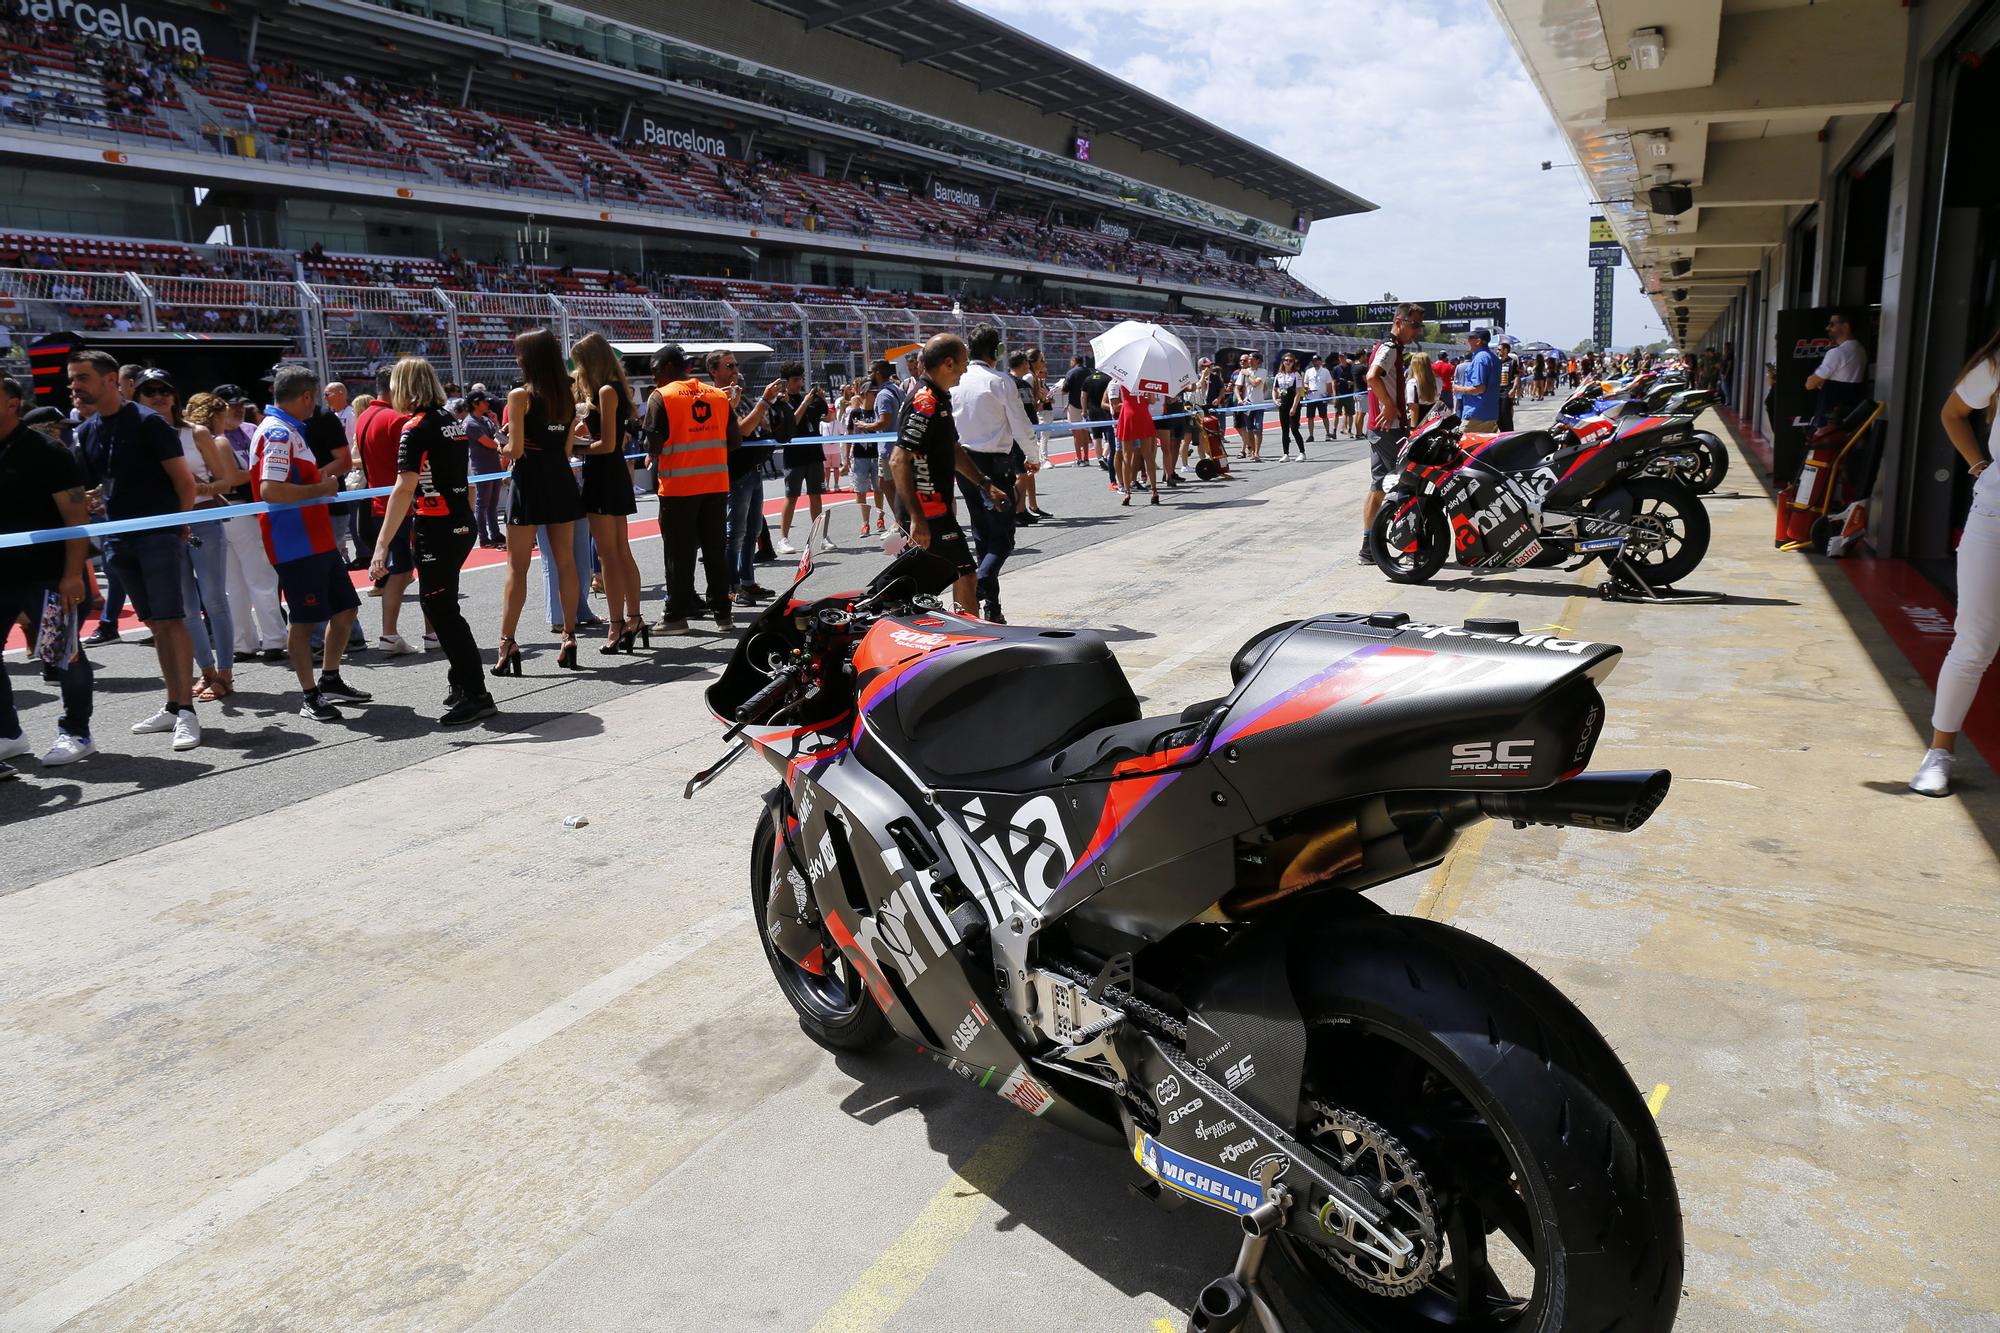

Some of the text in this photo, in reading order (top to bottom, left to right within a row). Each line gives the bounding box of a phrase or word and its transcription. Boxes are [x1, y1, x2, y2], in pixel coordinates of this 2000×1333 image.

[643, 119, 726, 157] Barcelona
[934, 182, 980, 208] Barcelona
[1101, 219, 1129, 239] Barcelona
[1291, 308, 1340, 318] MONSTER
[1368, 305, 1397, 315] MONS
[1449, 301, 1500, 312] MONSTER
[1145, 382, 1163, 391] GIVI
[547, 424, 565, 432] aprilia
[1447, 497, 1460, 510] sky
[1502, 529, 1522, 548] CASE
[1514, 542, 1542, 567] Castrol
[889, 629, 948, 646] aprilia
[896, 641, 933, 652] RACING
[1397, 622, 1600, 654] apilia
[1572, 704, 1600, 762] racer
[1451, 739, 1536, 764] SC
[1450, 763, 1532, 771] PROJECT
[1569, 811, 1617, 827] SC
[808, 852, 826, 885] sky
[951, 1013, 981, 1052] CASE
[1205, 1040, 1232, 1063] SHAREBOT
[1224, 1053, 1255, 1085] SC
[1227, 1069, 1256, 1090] PROJECT
[1204, 1119, 1227, 1136] SPRINT
[1212, 1121, 1237, 1139] FILTER
[1161, 1160, 1259, 1210] MICHELIN
